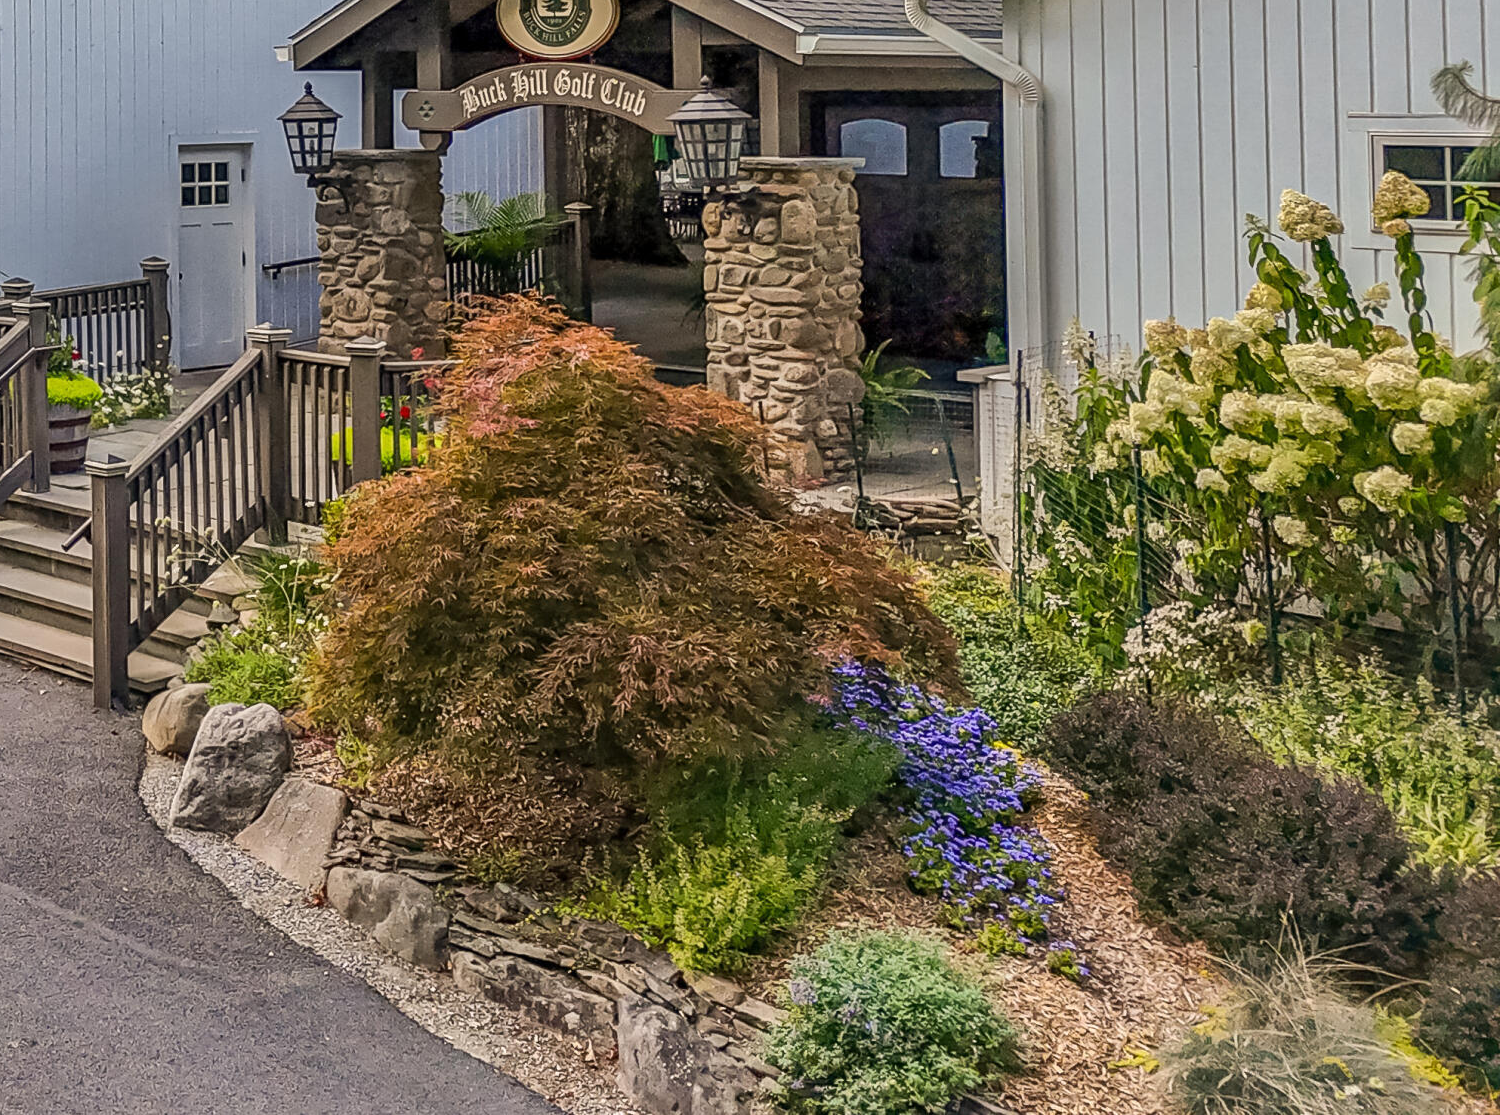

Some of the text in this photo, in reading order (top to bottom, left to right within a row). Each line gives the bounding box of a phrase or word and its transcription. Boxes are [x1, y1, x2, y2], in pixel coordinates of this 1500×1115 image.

[523, 11, 586, 42] BUCK HILL FALLS
[460, 68, 647, 118] Buck Hill Golf Club
